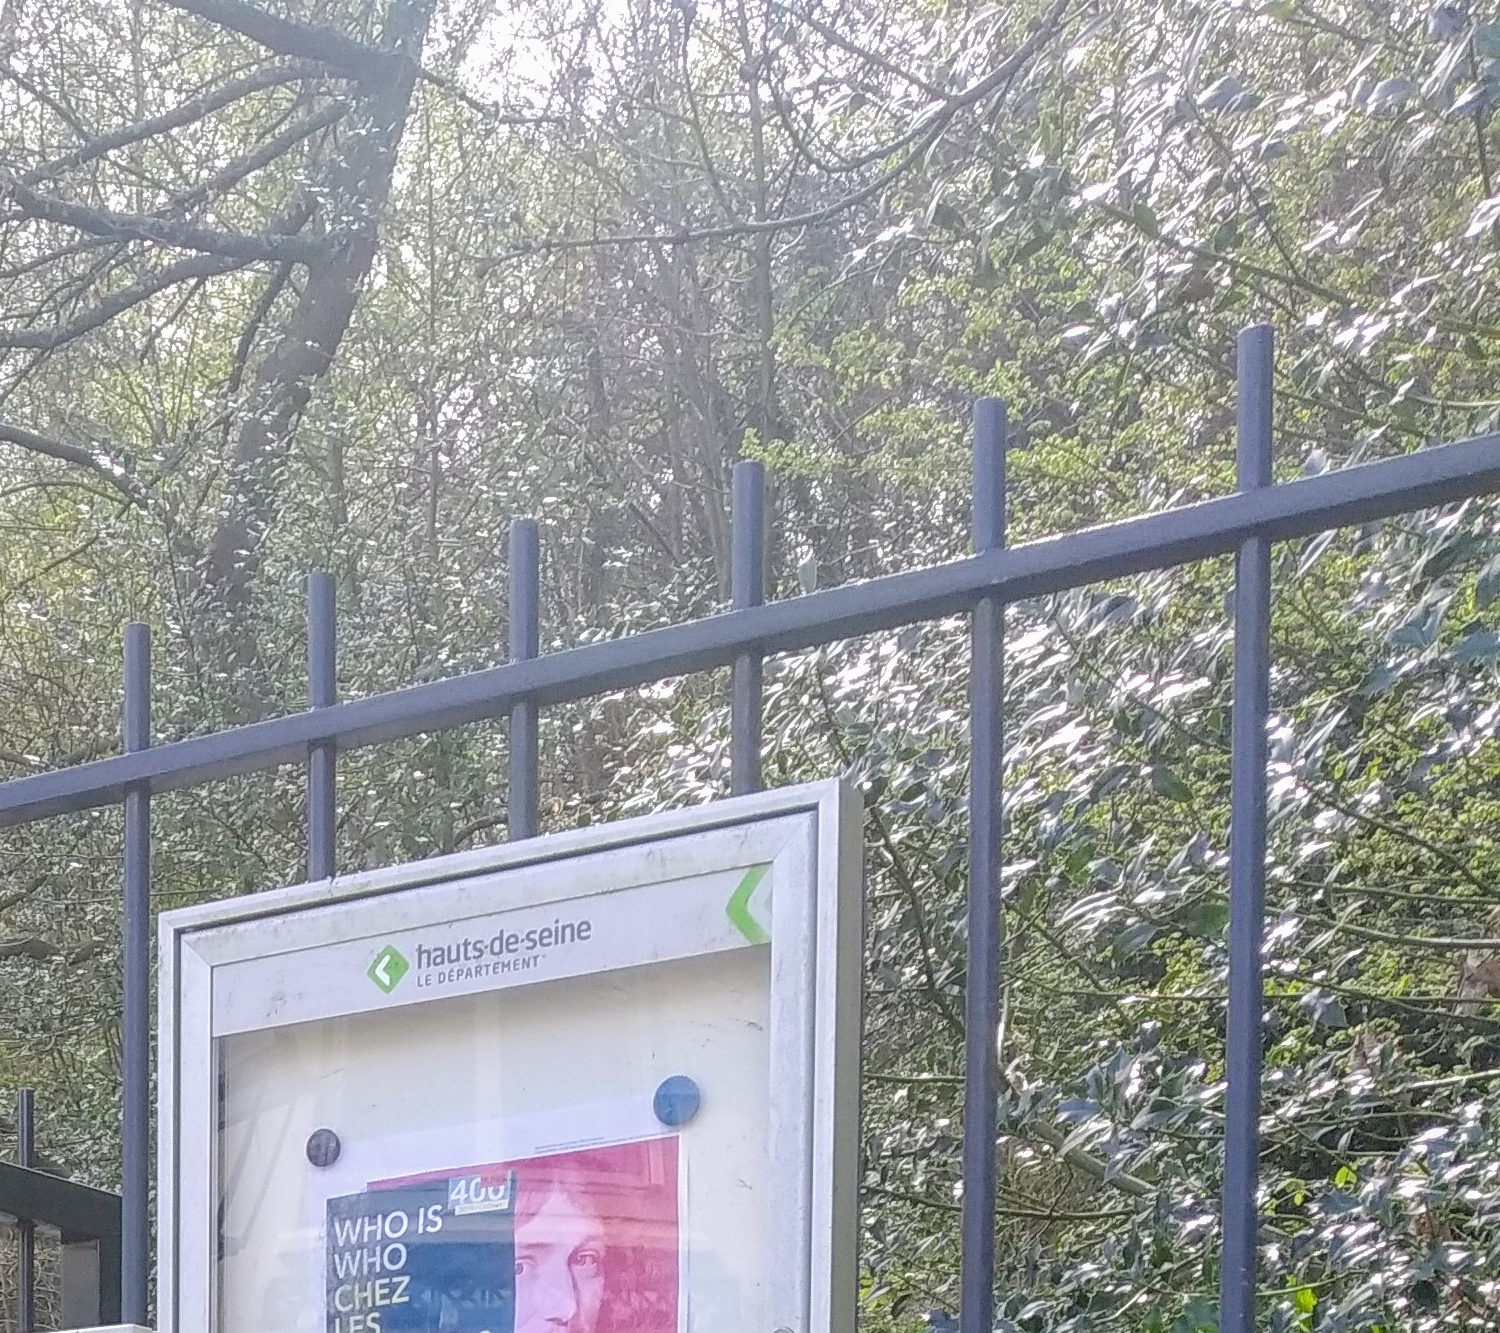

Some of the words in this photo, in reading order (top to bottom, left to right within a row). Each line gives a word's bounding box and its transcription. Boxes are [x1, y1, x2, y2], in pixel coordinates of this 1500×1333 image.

[416, 919, 592, 969] hauts-de-seine
[417, 974, 432, 988] LE
[438, 955, 540, 985] DÉPARTEMENT
[334, 1211, 408, 1247] WHO
[417, 1205, 443, 1234] IS
[333, 1243, 407, 1279] WHO
[334, 1275, 411, 1312] CHEZ
